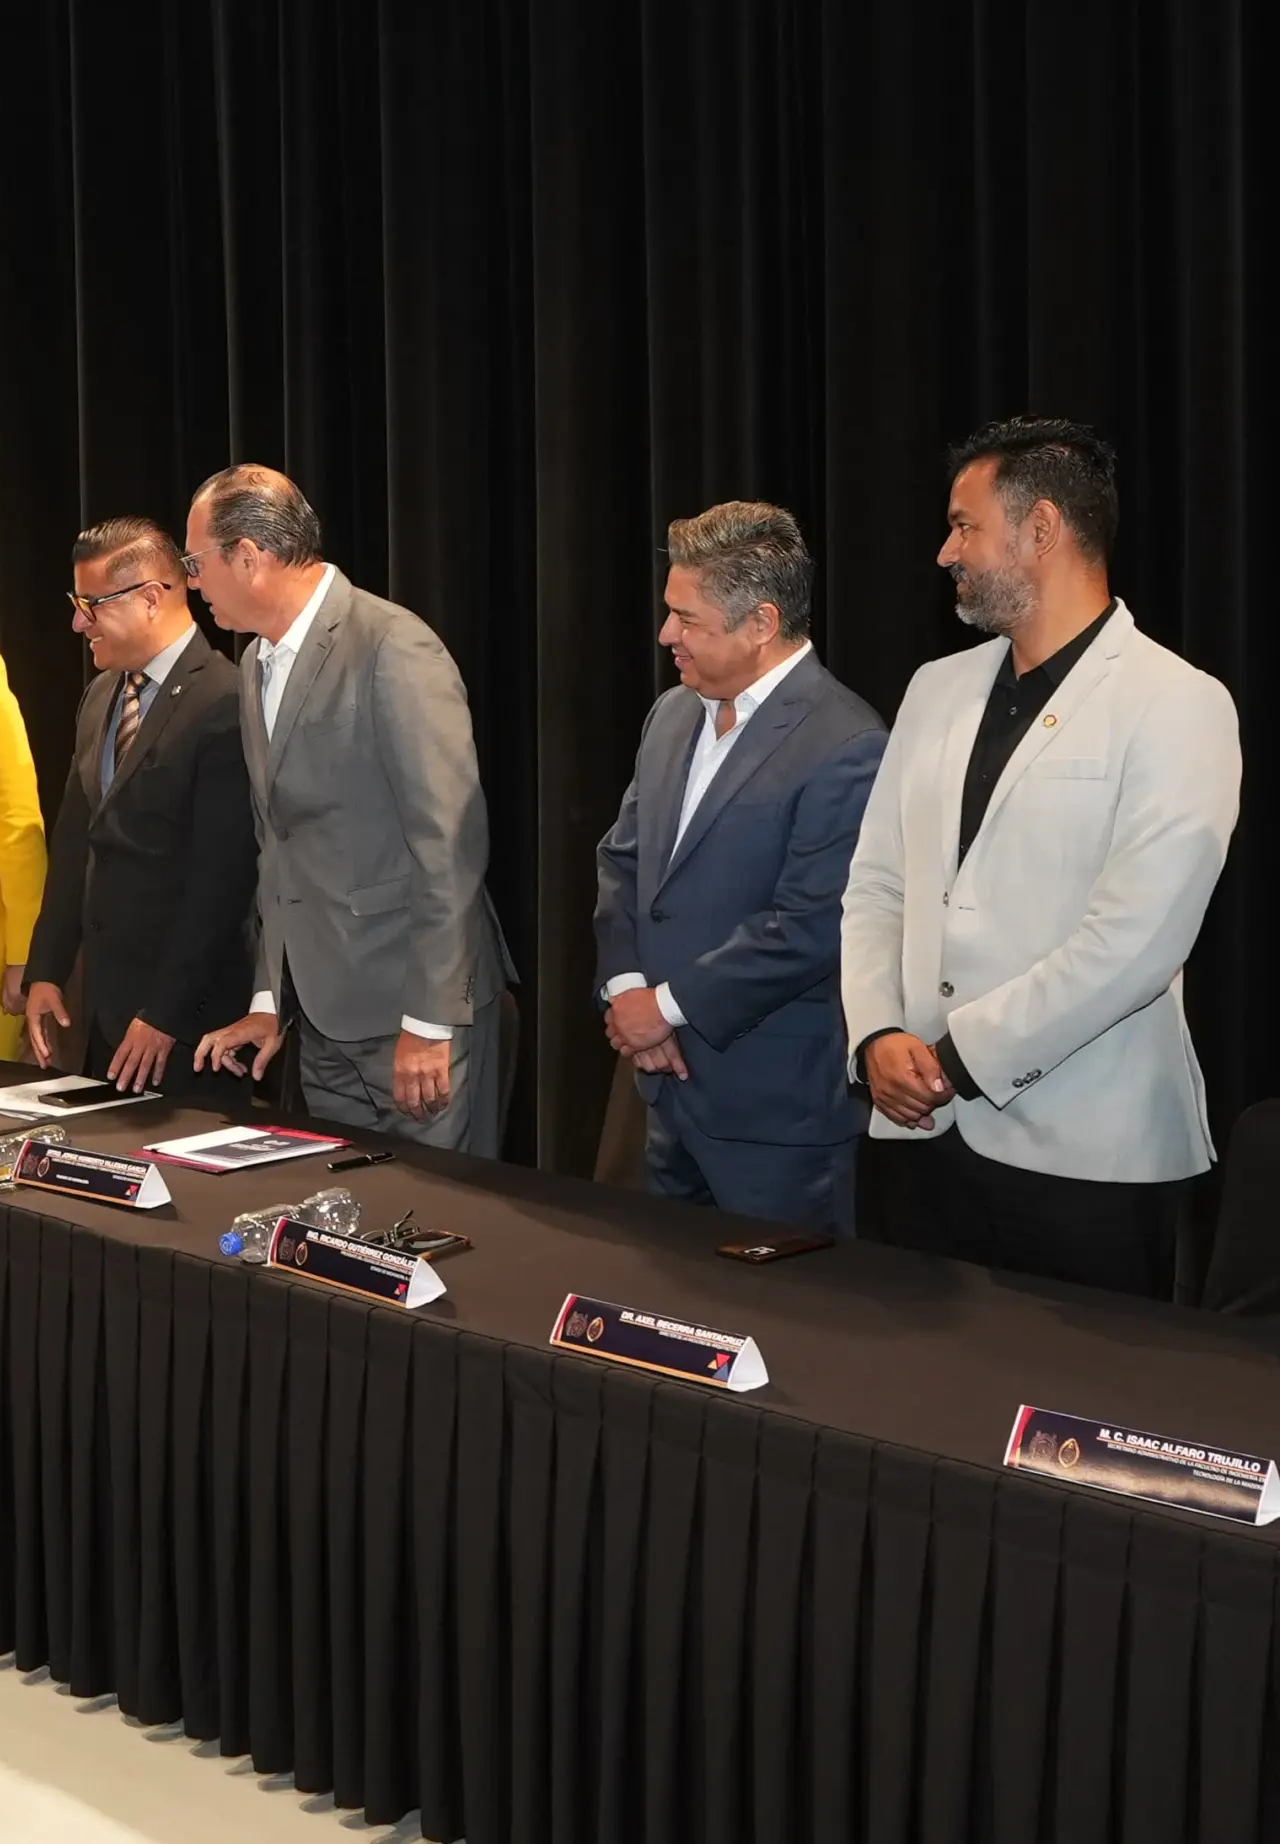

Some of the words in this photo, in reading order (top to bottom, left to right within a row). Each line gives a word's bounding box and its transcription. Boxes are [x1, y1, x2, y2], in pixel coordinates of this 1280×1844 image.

[320, 1234, 348, 1248] RICARDO
[635, 1314, 655, 1326] AXEL
[656, 1319, 695, 1335] BECERRA
[1099, 1428, 1111, 1439] M.
[1113, 1431, 1124, 1442] C.
[1126, 1434, 1161, 1450] ISAAC
[1160, 1442, 1206, 1460] ALFARO
[1207, 1451, 1261, 1473] TRUJILLO
